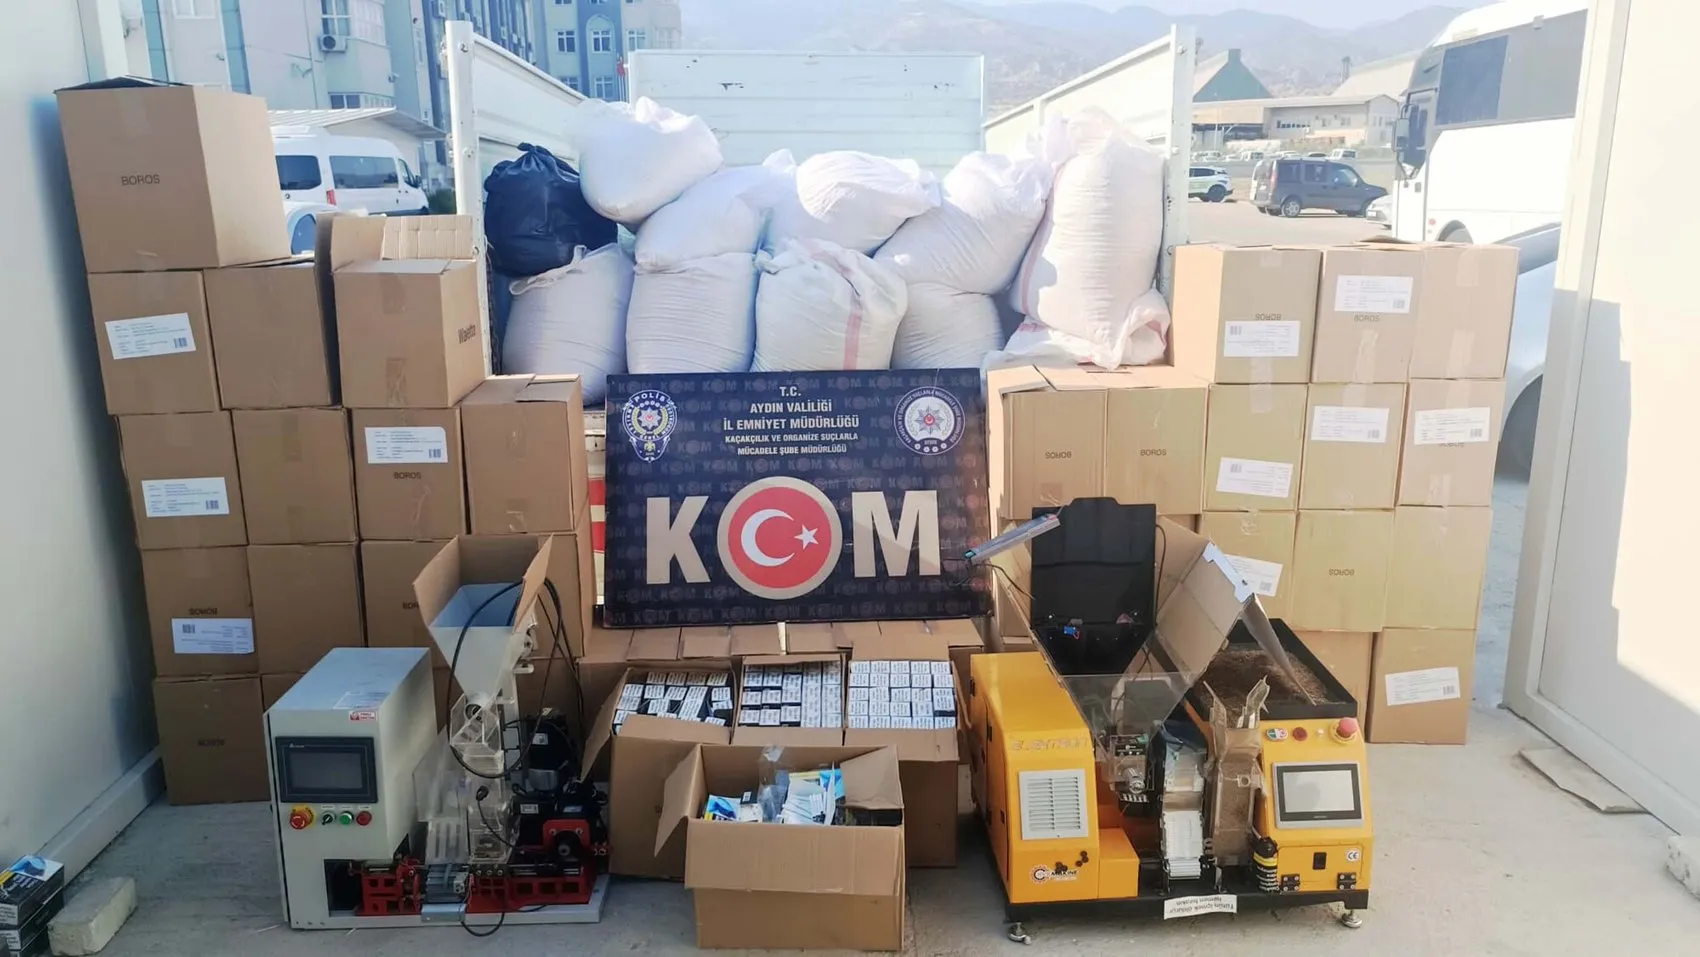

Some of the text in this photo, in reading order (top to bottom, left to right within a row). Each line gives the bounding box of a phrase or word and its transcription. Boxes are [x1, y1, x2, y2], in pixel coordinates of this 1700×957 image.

[121, 174, 160, 186] BOROS
[779, 386, 802, 397] T.C.
[750, 399, 832, 413] AYDIN VALİLİĞİ
[723, 414, 859, 430] İL EMNİYET MÜDÜRLÜĞÜ
[725, 432, 858, 444] KAÇAKÇILIK VE ORGANİZE SUÇLARLA
[738, 444, 847, 455] MÜCADELE ŞUBE MÜDÜRLÜĞÜ
[1045, 451, 1072, 459] BOROS
[1140, 449, 1167, 457] BOROS
[402, 601, 420, 610] BOR
